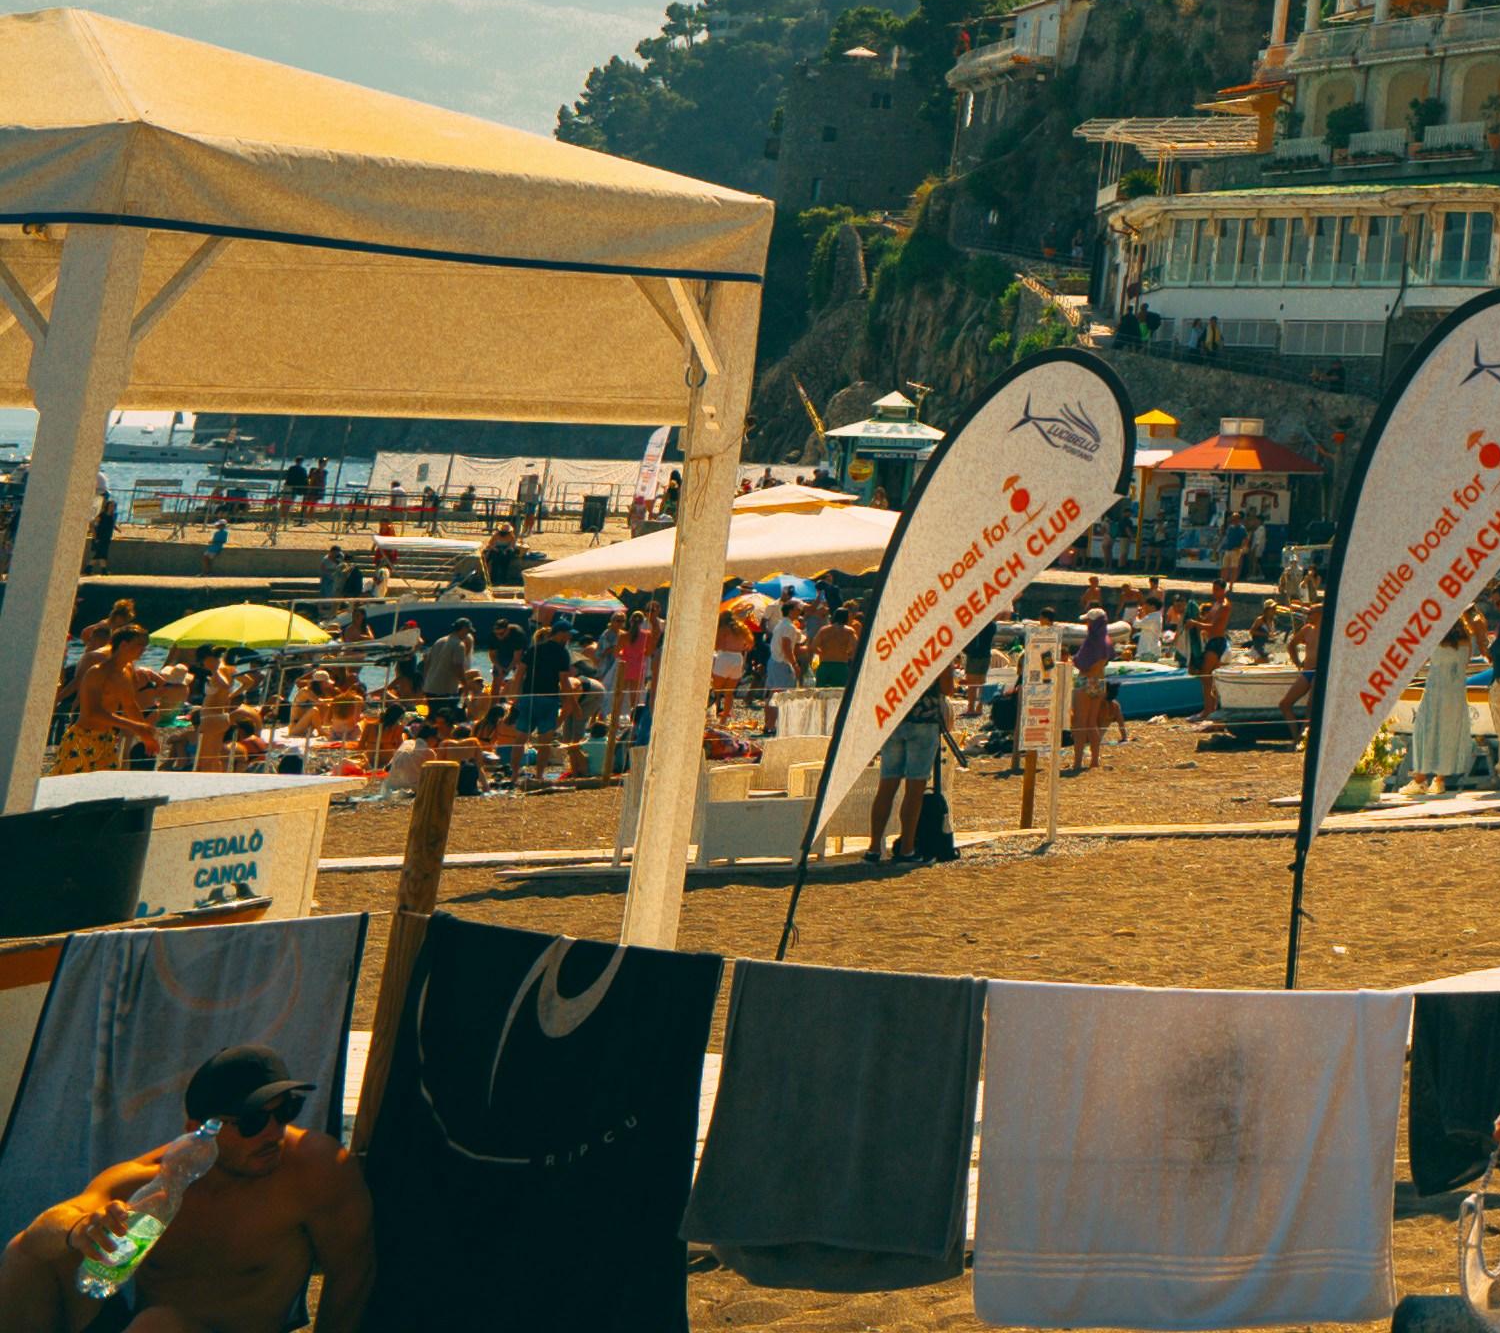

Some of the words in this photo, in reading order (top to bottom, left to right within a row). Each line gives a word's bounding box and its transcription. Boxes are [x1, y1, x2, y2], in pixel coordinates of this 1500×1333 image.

[1047, 423, 1100, 453] LUCIBELLO
[874, 625, 953, 729] ARIENZO
[954, 552, 1025, 629] BEACH
[1026, 497, 1081, 557] CLUB
[875, 589, 938, 662] Shuttle
[938, 542, 985, 592] boat
[982, 515, 1010, 549] for
[1345, 563, 1413, 646] Shuttle
[1408, 506, 1460, 564] boat
[1452, 473, 1485, 511] for
[1359, 598, 1442, 716] ARIENZO
[189, 828, 264, 862] PEDALÒ
[194, 861, 258, 889] CANOA
